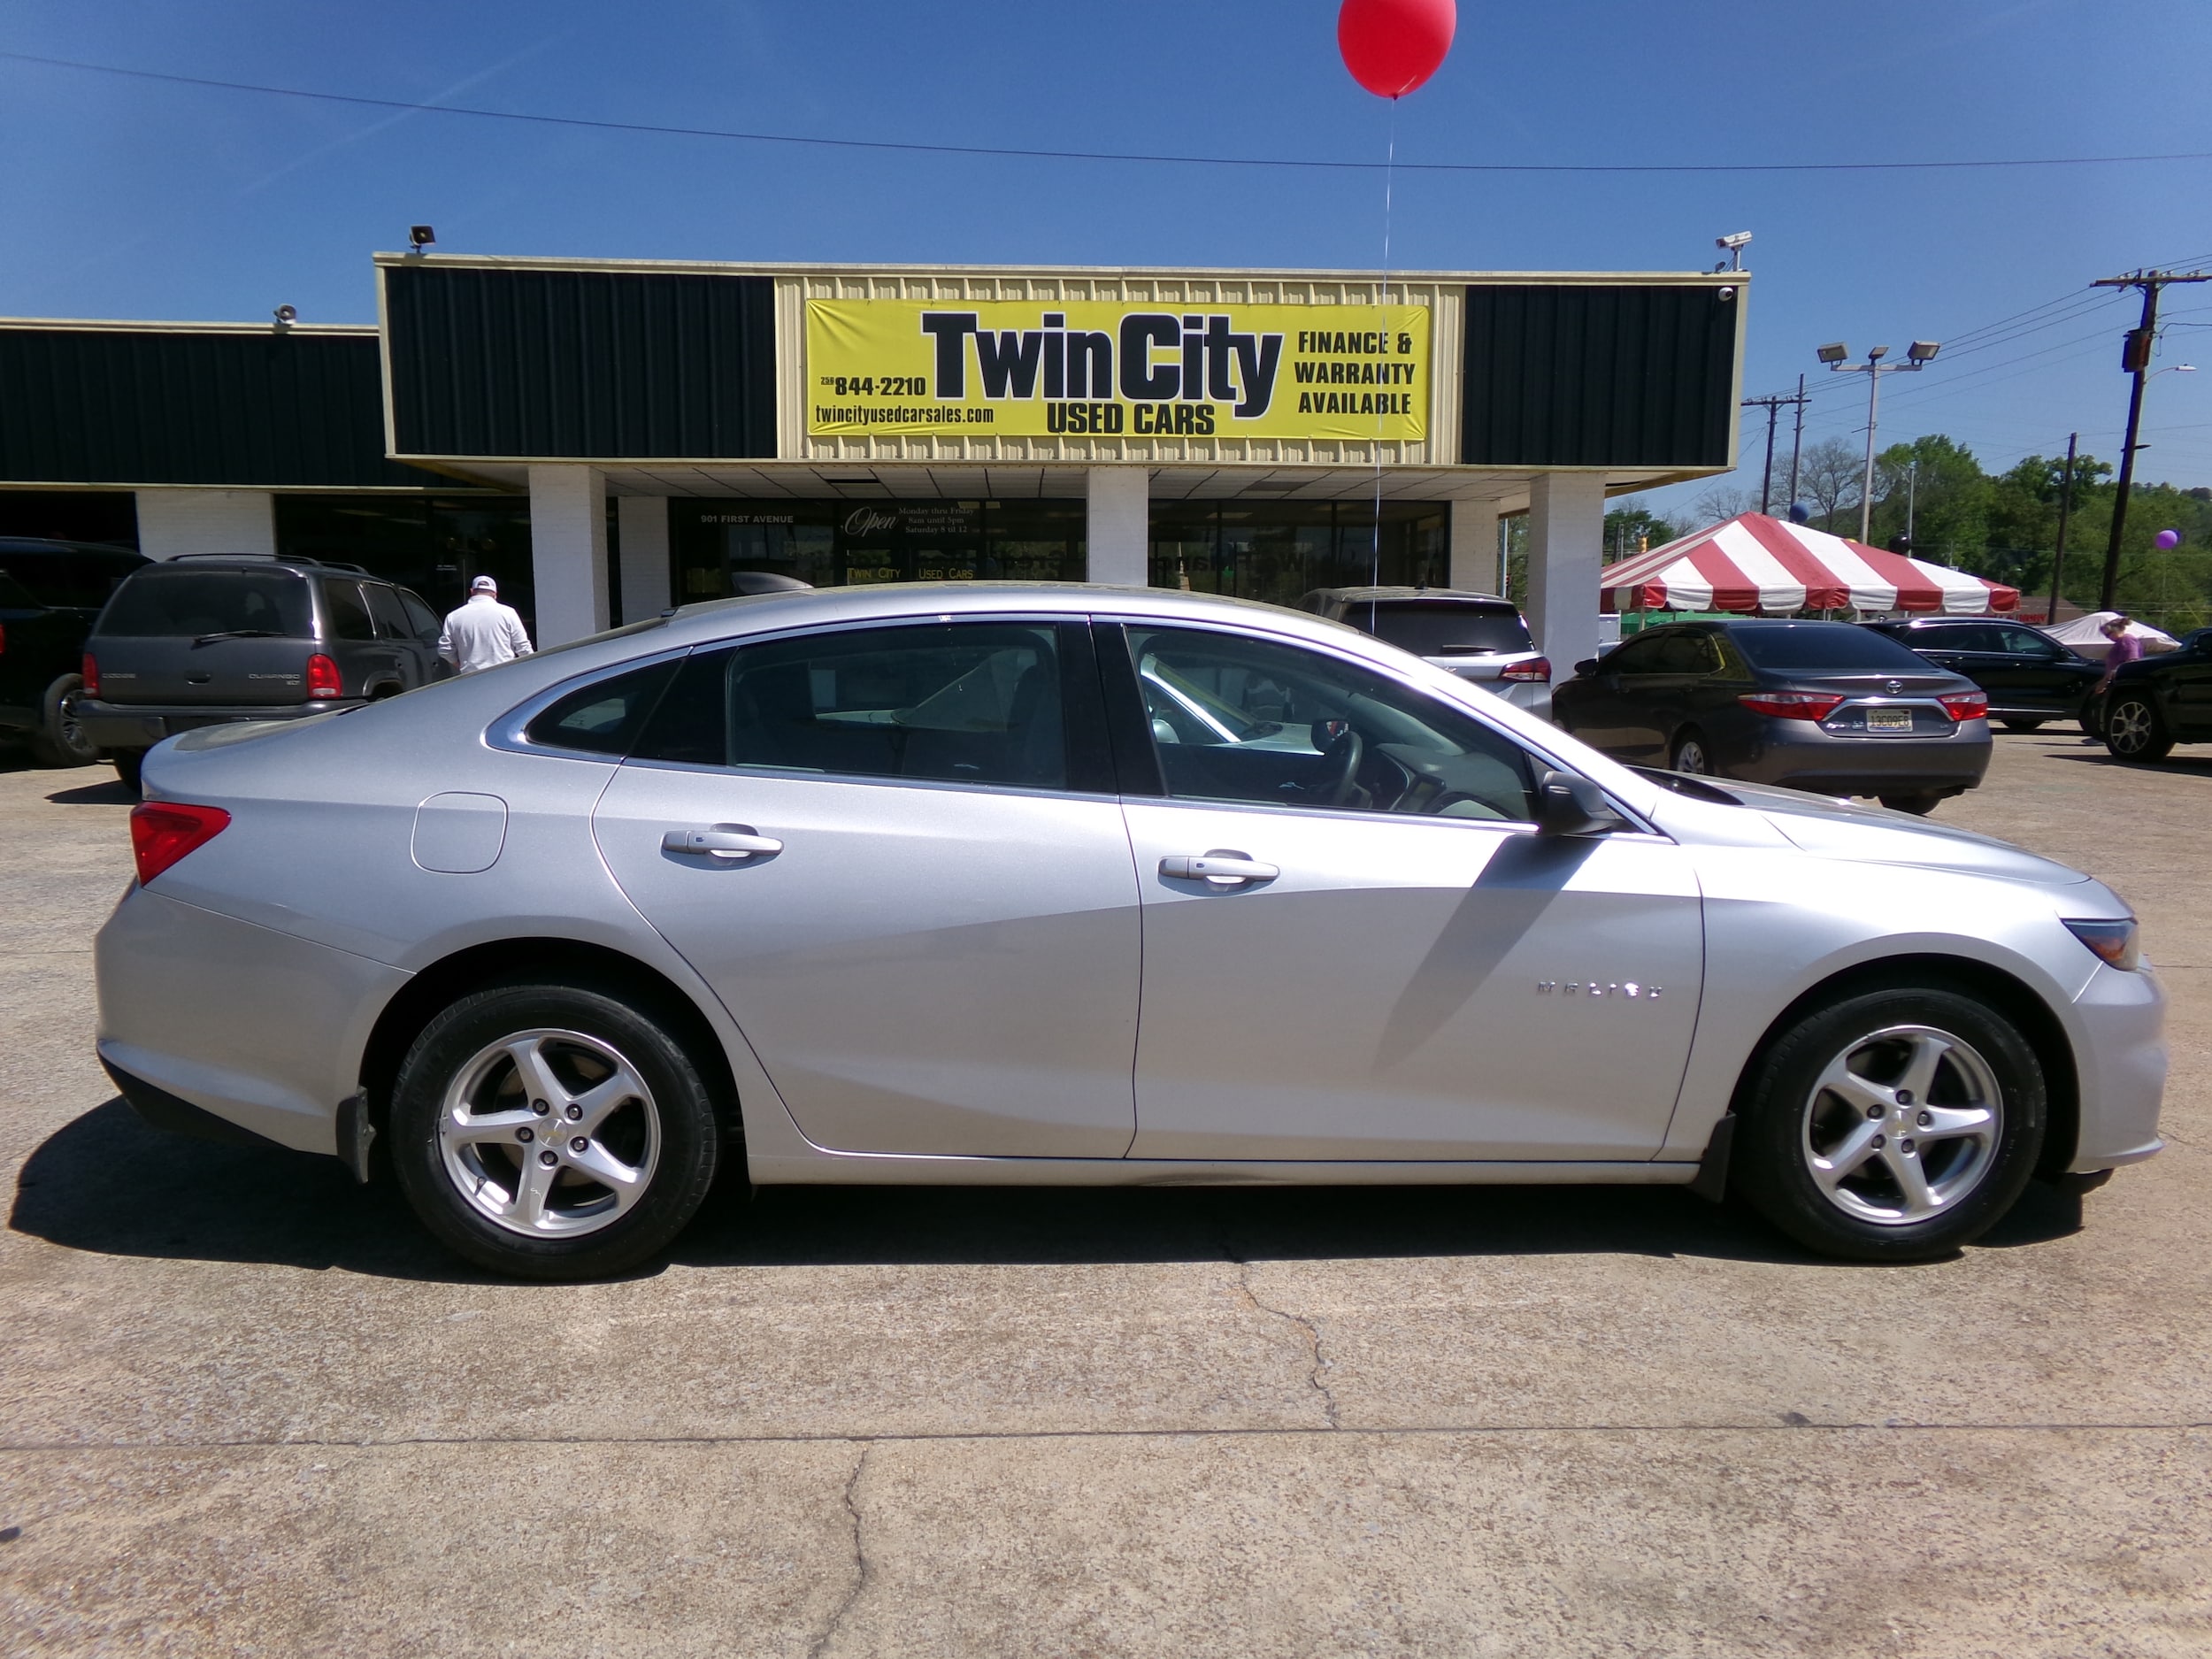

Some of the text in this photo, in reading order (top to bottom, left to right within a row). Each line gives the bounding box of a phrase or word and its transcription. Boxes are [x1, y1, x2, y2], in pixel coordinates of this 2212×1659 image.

[1298, 331, 1412, 355] FINANCE &
[1294, 361, 1417, 385] WARRANTY
[834, 377, 926, 396] 844-2210
[1297, 391, 1411, 415] AVAILABLE
[816, 404, 994, 426] twincityusedcarsales.com
[1047, 402, 1215, 435] USED CARS
[701, 515, 794, 524] 901 FIRST AVENUE
[844, 506, 899, 537] Open
[898, 507, 931, 516] Monday
[950, 507, 974, 516] Friday
[905, 526, 938, 534] Saturday
[878, 567, 901, 579] CITY
[918, 568, 943, 580] USED
[949, 567, 973, 580] CARS
